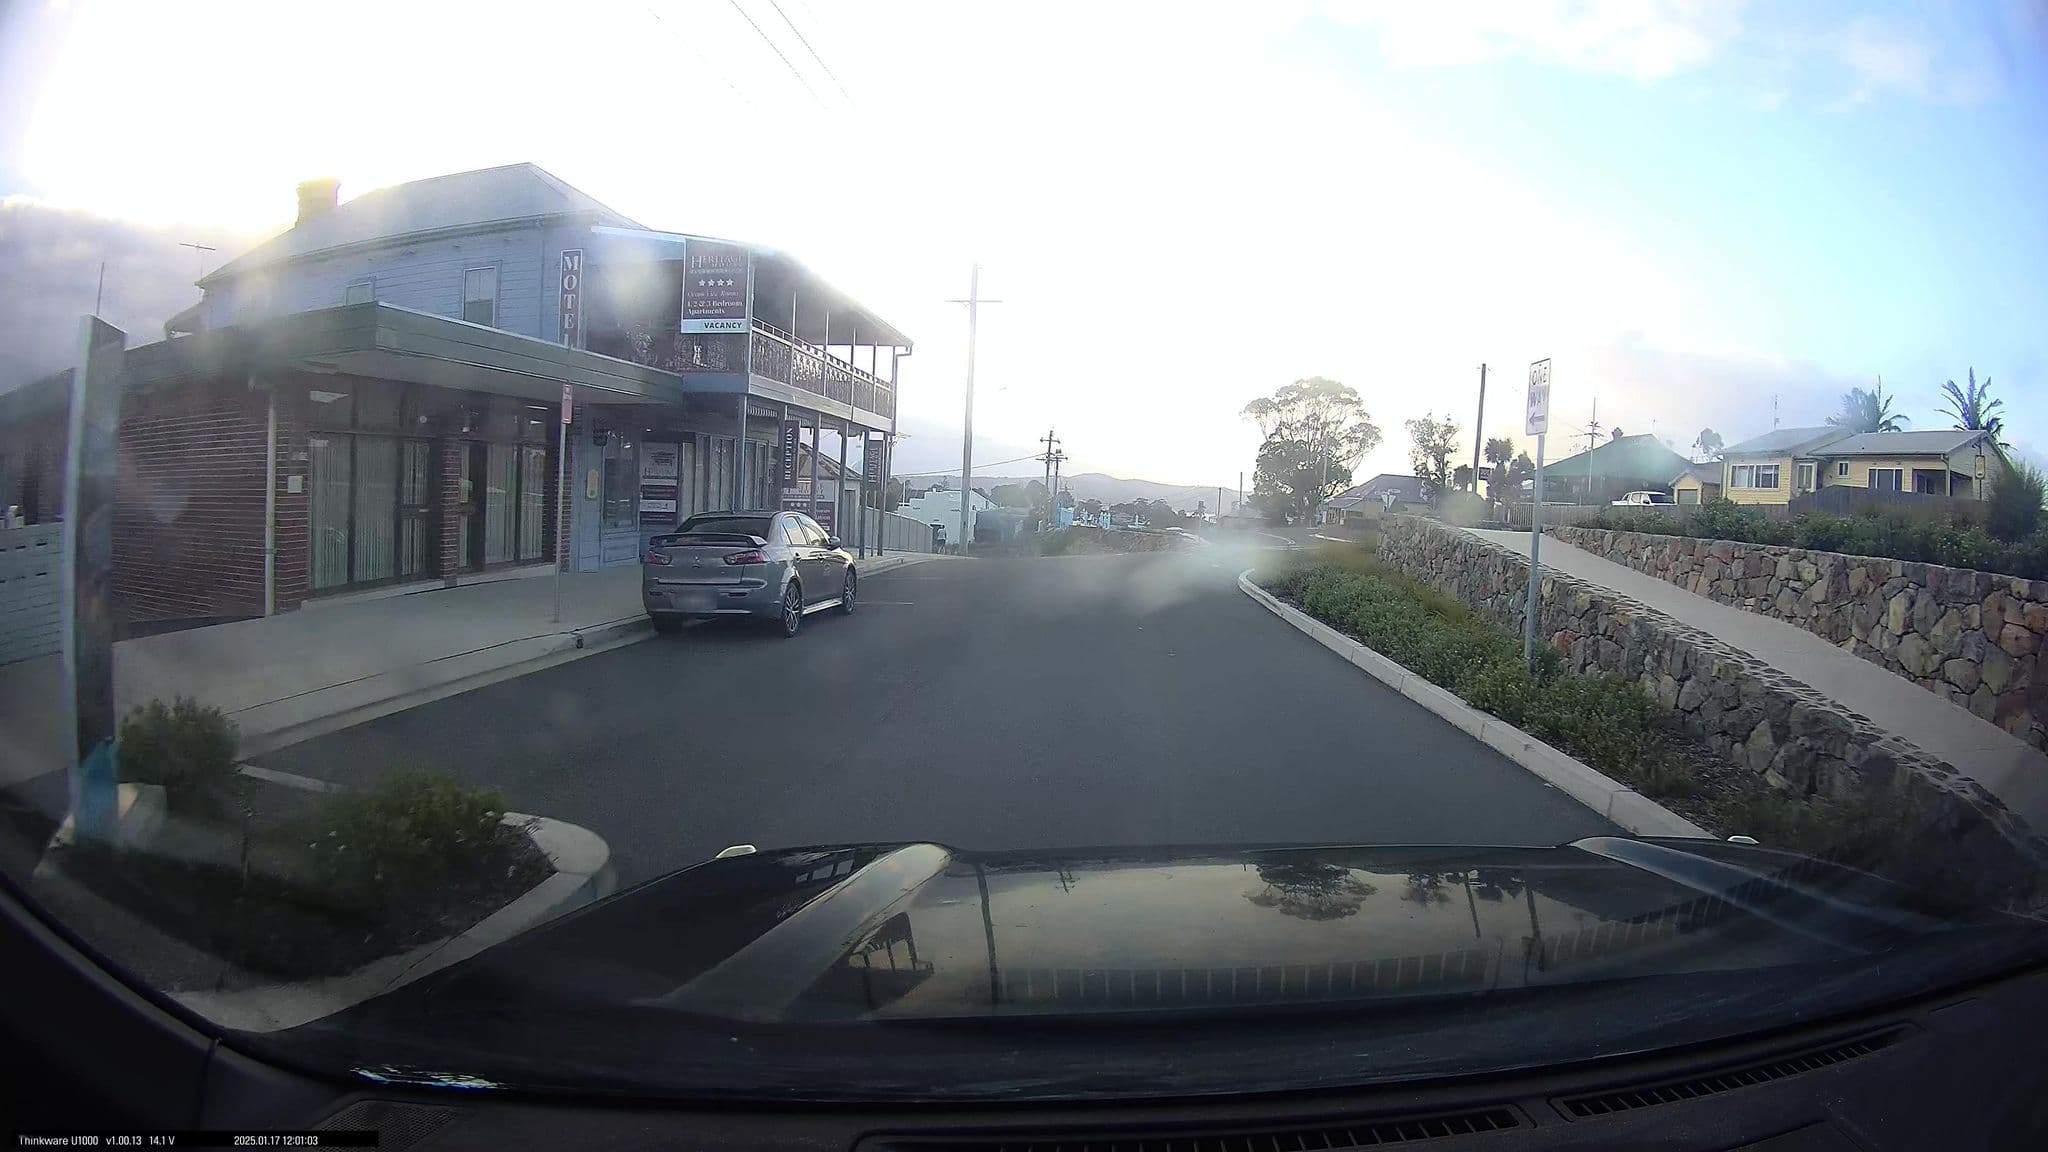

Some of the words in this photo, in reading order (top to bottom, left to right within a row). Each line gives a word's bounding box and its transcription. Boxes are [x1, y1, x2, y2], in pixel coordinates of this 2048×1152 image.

[687, 308, 726, 316] Apartments
[1532, 365, 1548, 385] ONE
[1530, 388, 1546, 408] WAY
[784, 427, 793, 480] RECEPTION
